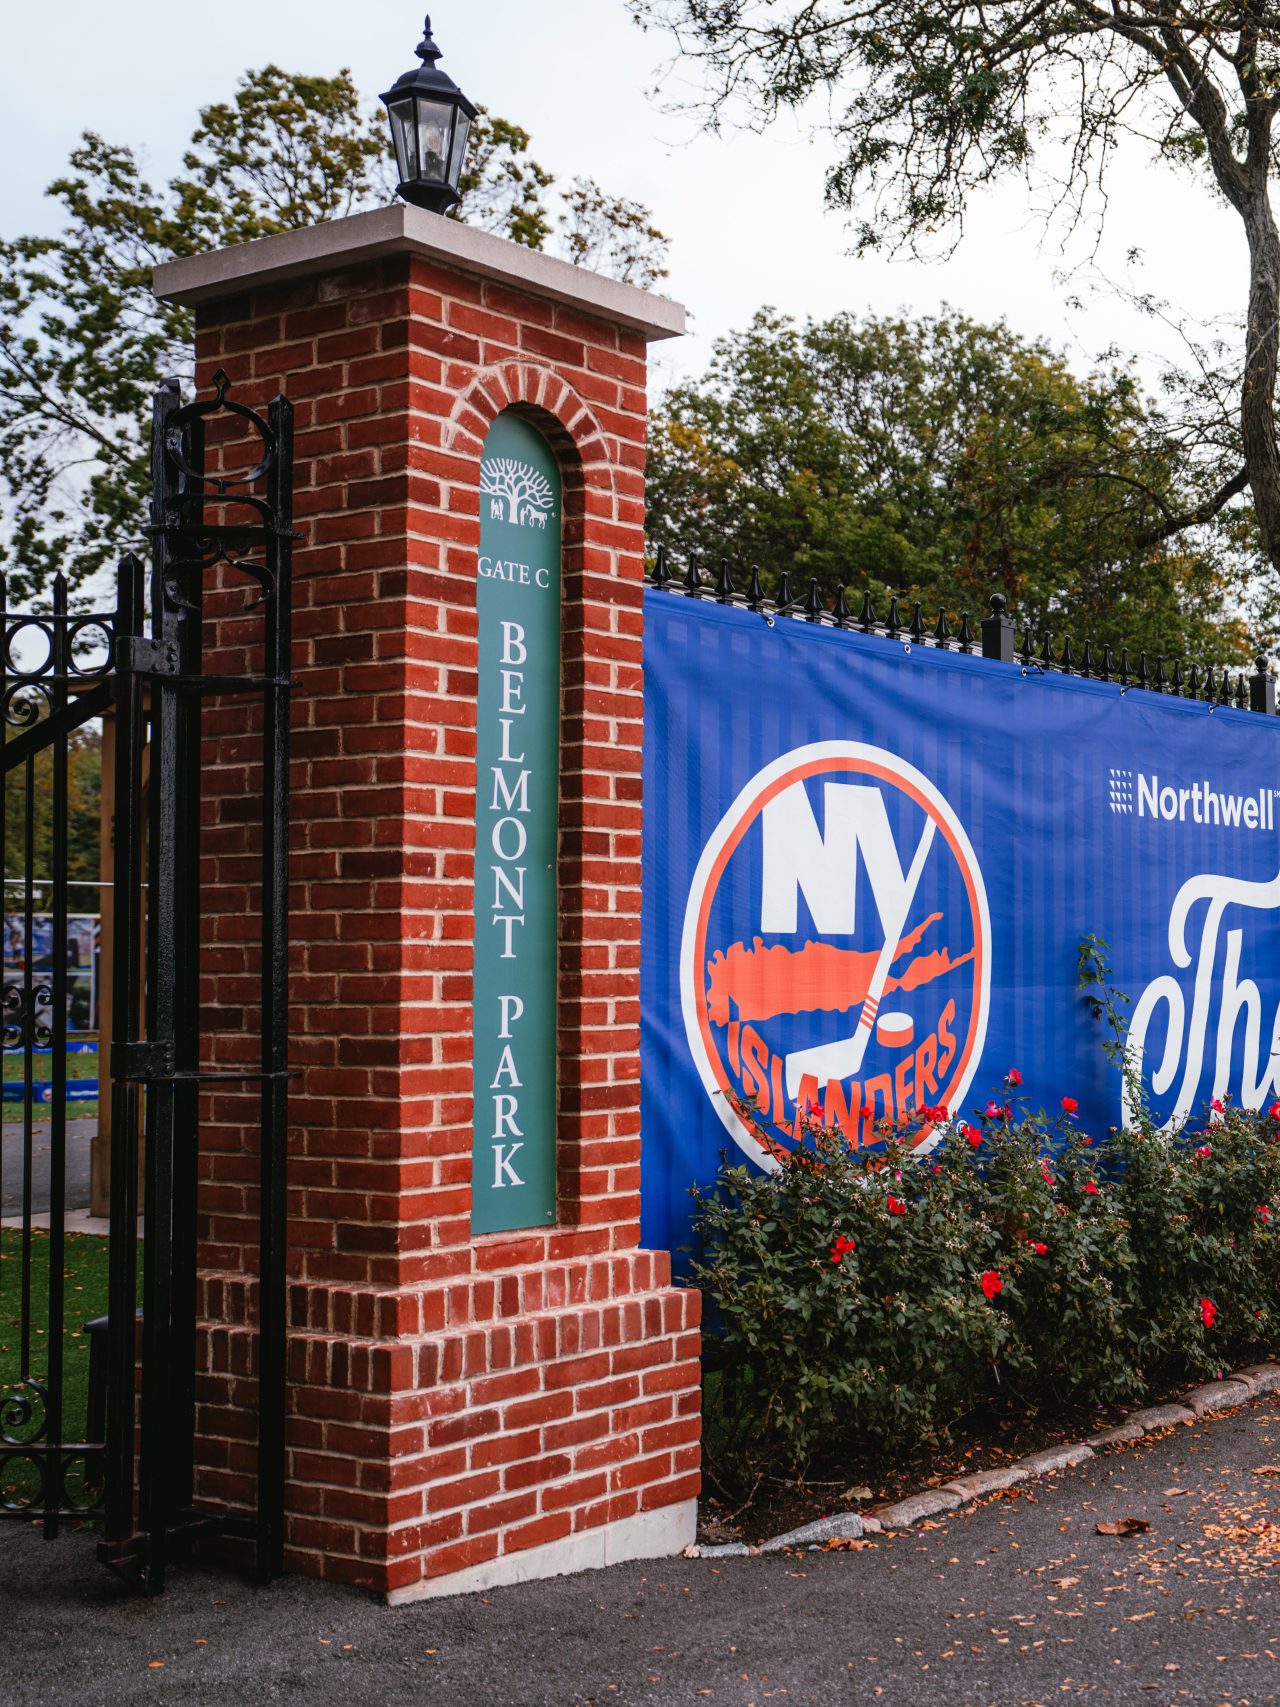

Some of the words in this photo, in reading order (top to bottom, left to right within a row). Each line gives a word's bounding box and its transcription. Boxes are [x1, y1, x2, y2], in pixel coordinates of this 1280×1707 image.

[477, 556, 531, 585] GATE
[535, 568, 550, 589] C
[489, 620, 531, 958] BELMONT
[761, 780, 938, 940] NY
[1137, 773, 1274, 831] Northwell
[489, 994, 526, 1188] PARK
[727, 998, 957, 1151] ISLANDERS
